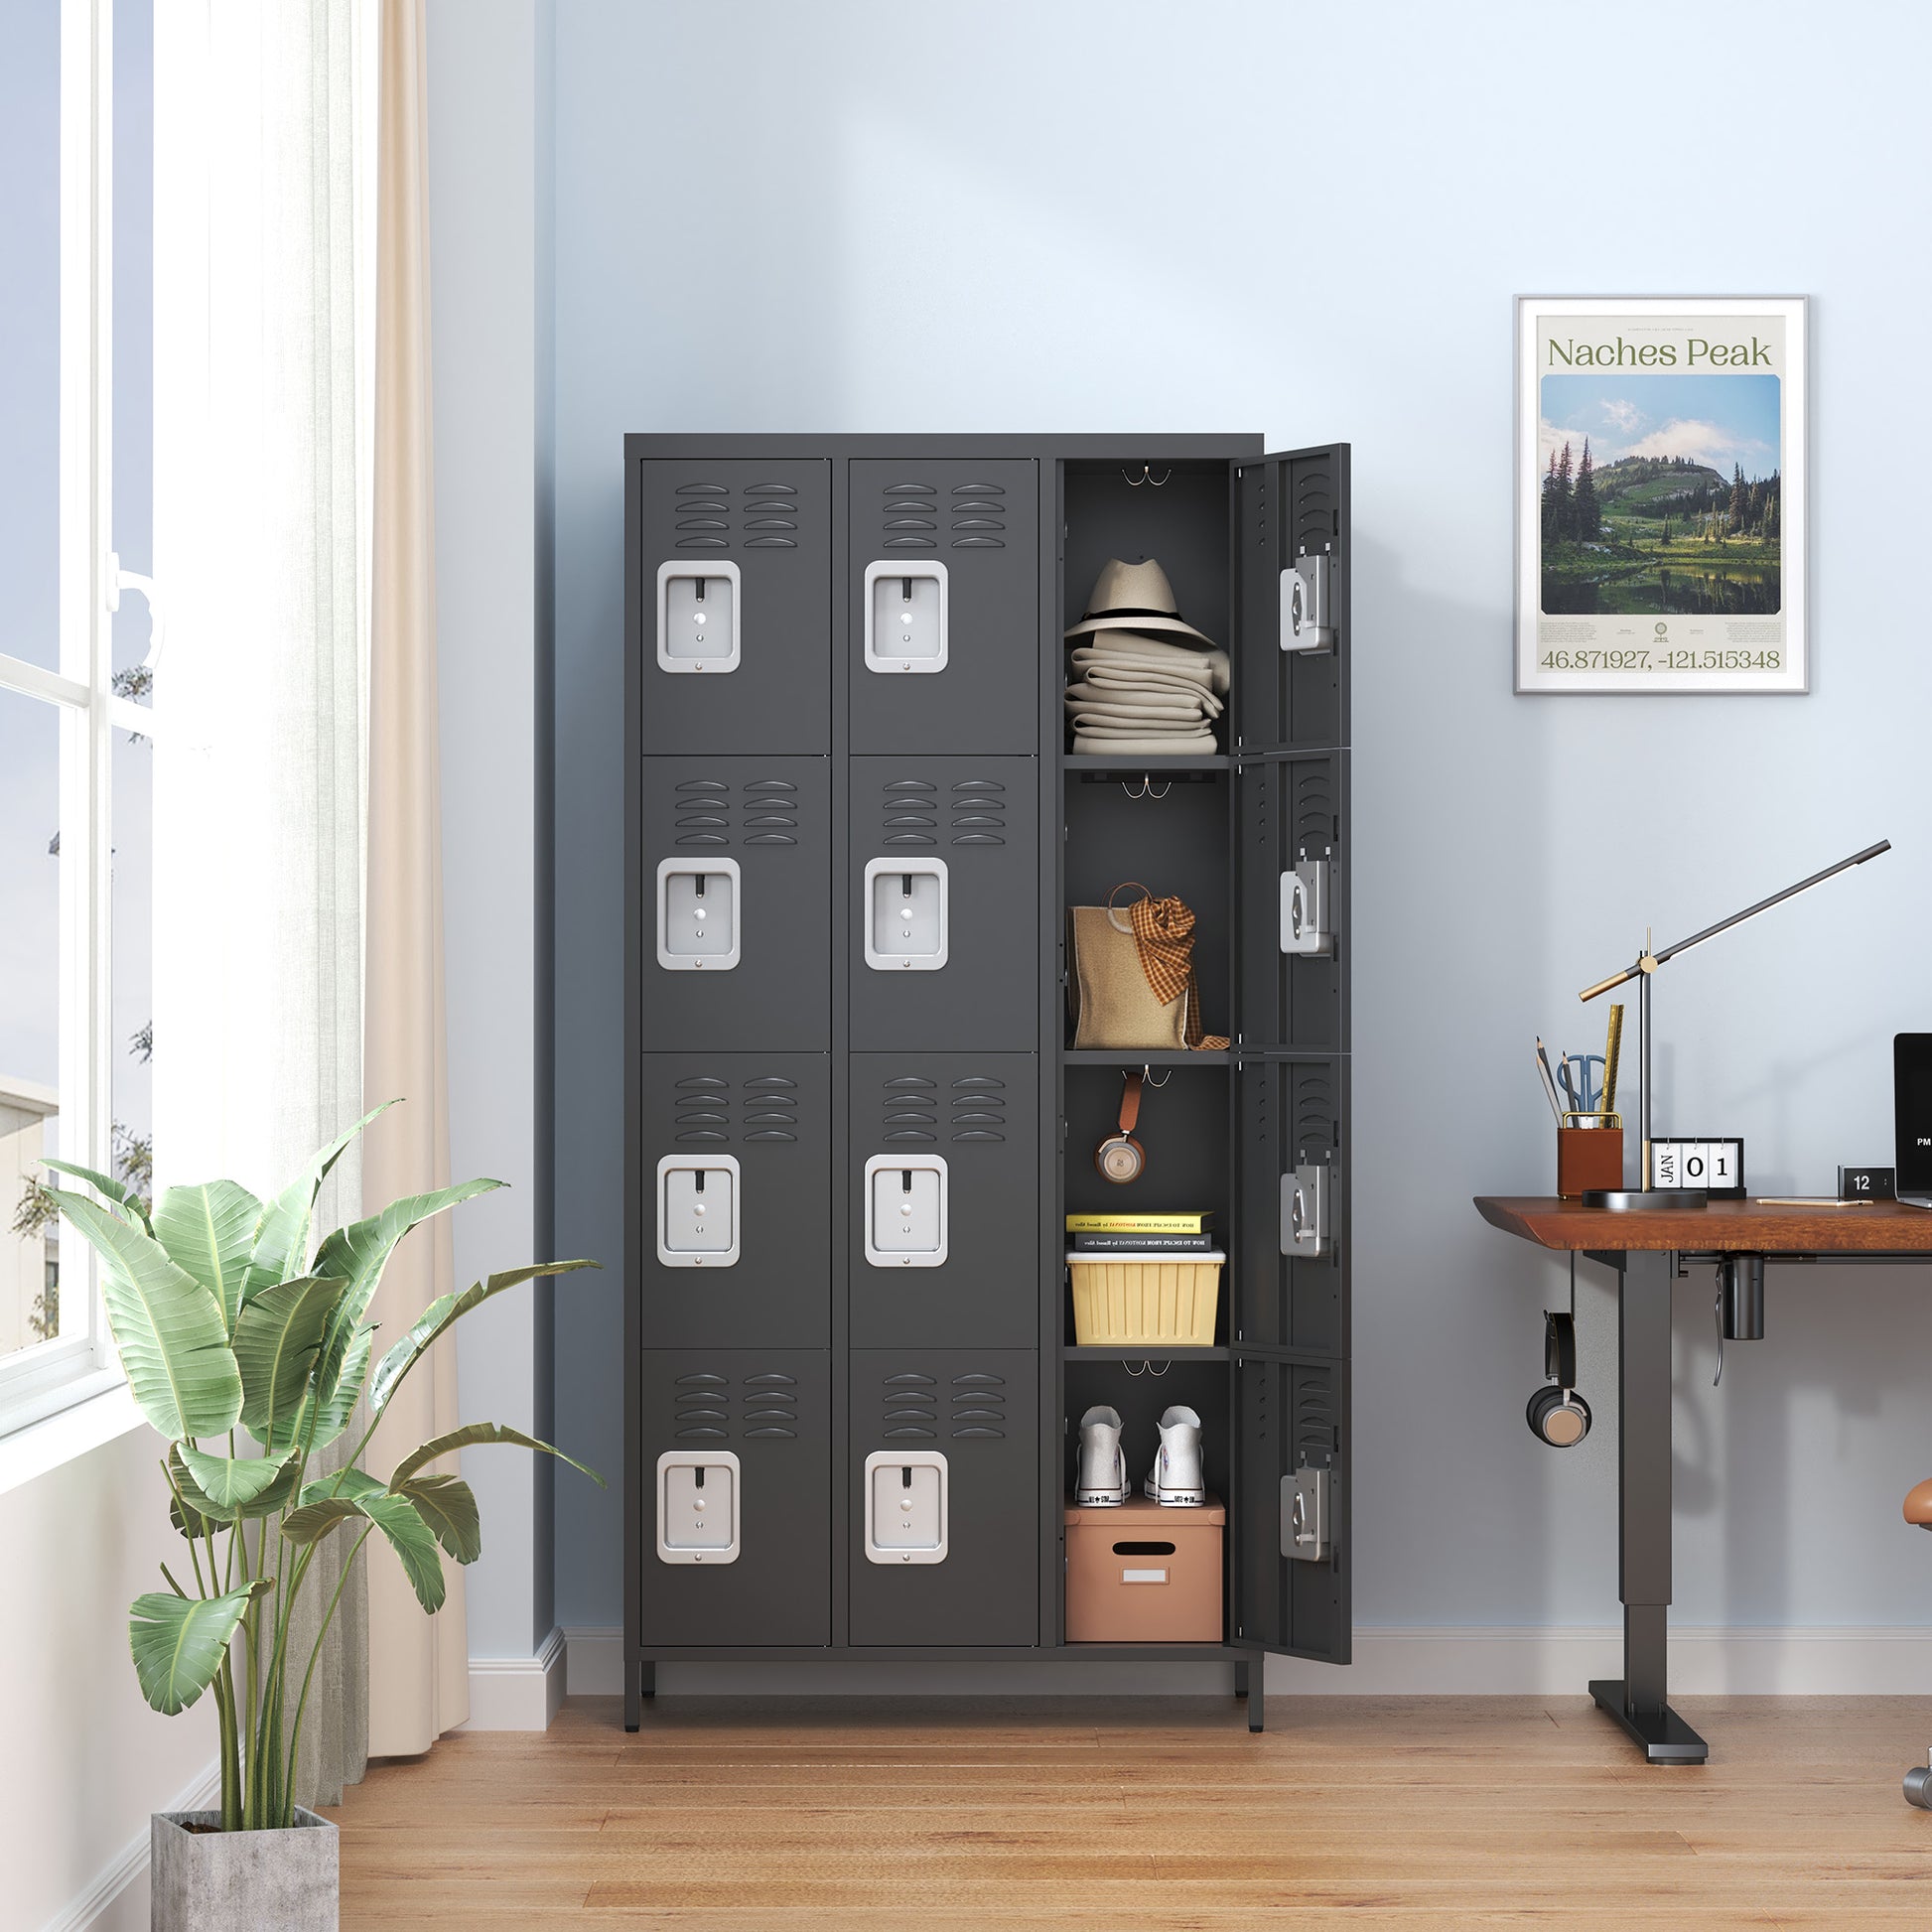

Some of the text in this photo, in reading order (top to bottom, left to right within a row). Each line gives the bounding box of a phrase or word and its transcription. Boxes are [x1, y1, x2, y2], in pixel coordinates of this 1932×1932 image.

[1549, 337, 1773, 366] Naches Peak
[1541, 650, 1780, 671] 46.871927, -121.515348
[1661, 1155, 1673, 1182] JAN
[1854, 1175, 1870, 1190] 12
